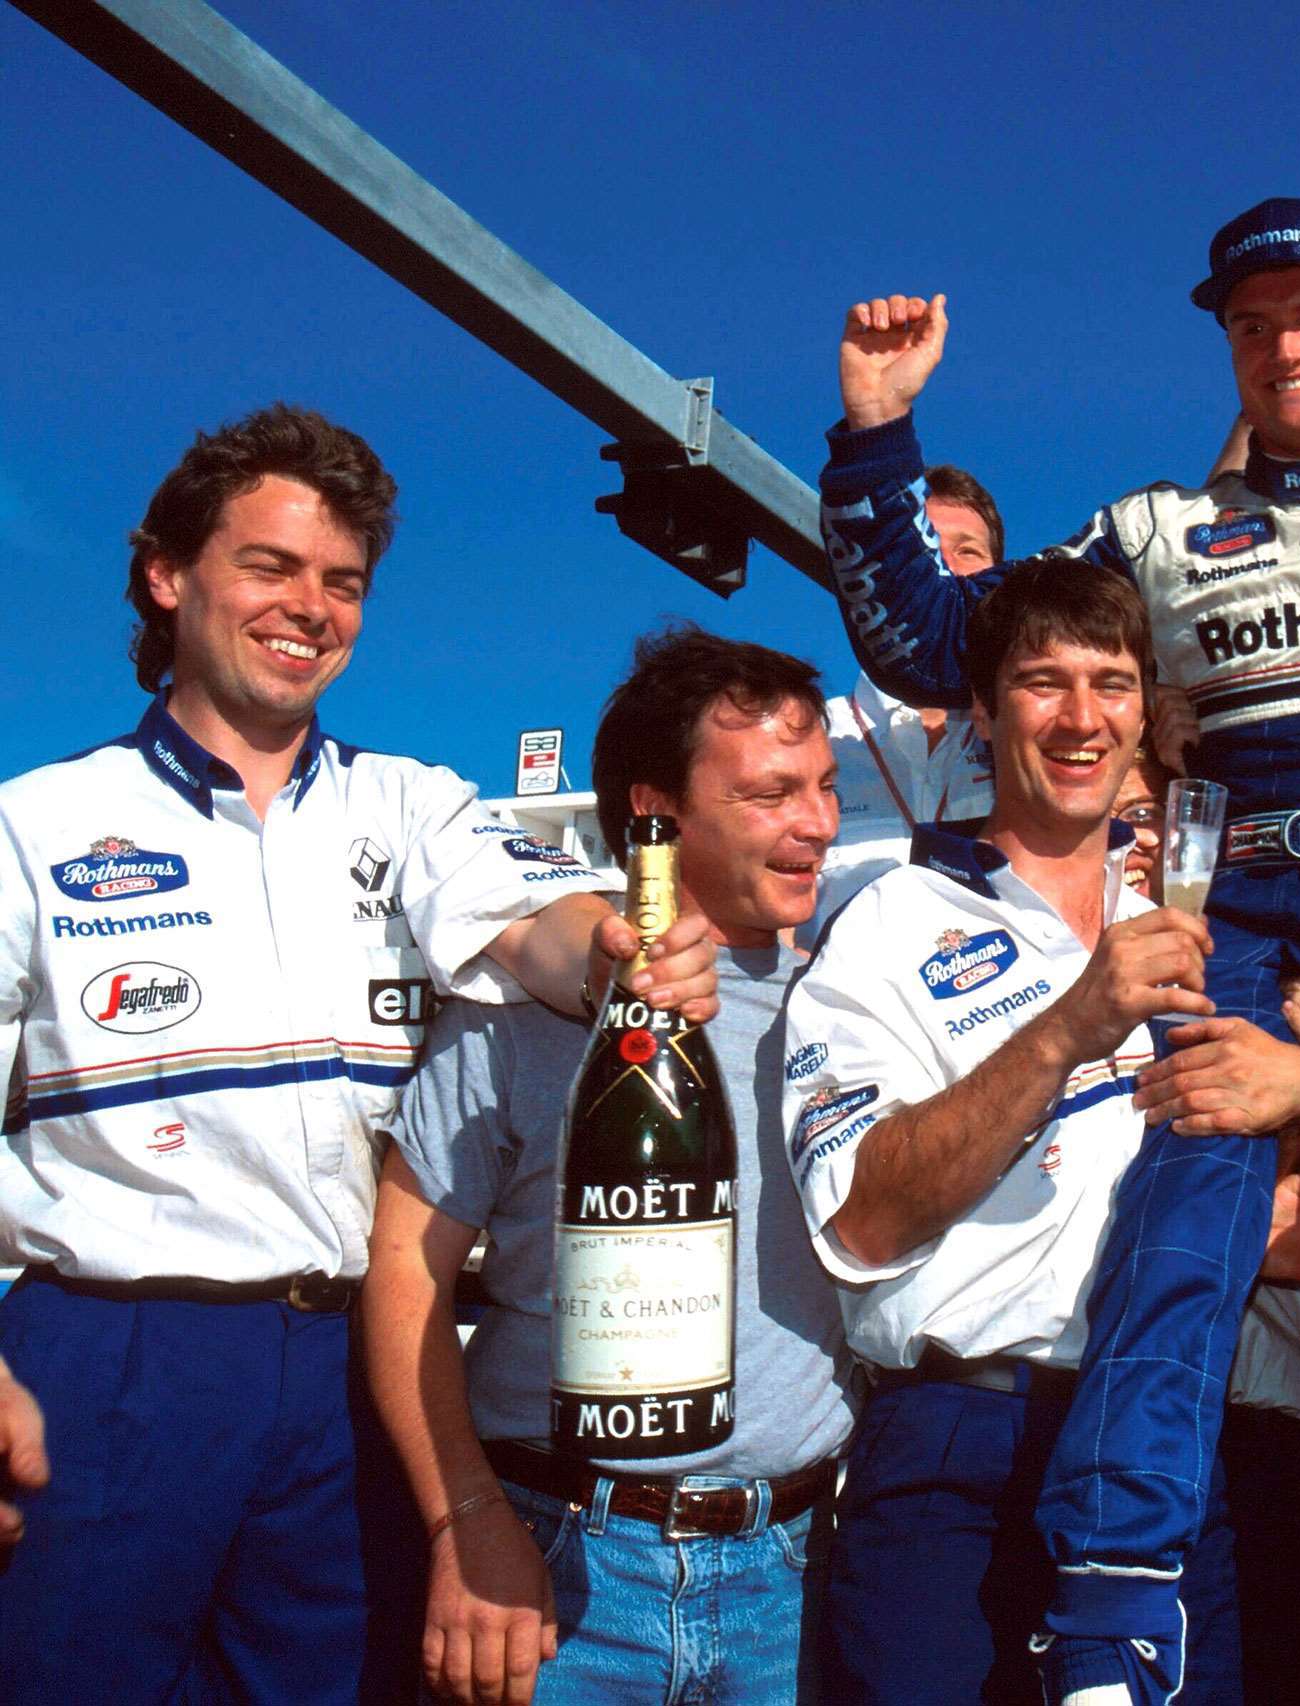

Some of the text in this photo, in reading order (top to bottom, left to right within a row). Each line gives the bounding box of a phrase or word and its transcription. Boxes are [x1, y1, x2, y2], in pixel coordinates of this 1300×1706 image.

[1186, 558, 1278, 585] Rothmans
[154, 739, 201, 789] Rothmans
[62, 860, 179, 885] Rothmans
[52, 910, 214, 938] Rothmans
[925, 938, 1008, 986] Rothmans
[97, 973, 190, 1022] Segafredo
[944, 979, 1052, 1041] Rothmans
[579, 1178, 696, 1220] MOËT
[571, 1237, 607, 1252] BRUT
[600, 1300, 615, 1318] &
[624, 1293, 721, 1318] CHANDON
[577, 1396, 693, 1438] MOËT
